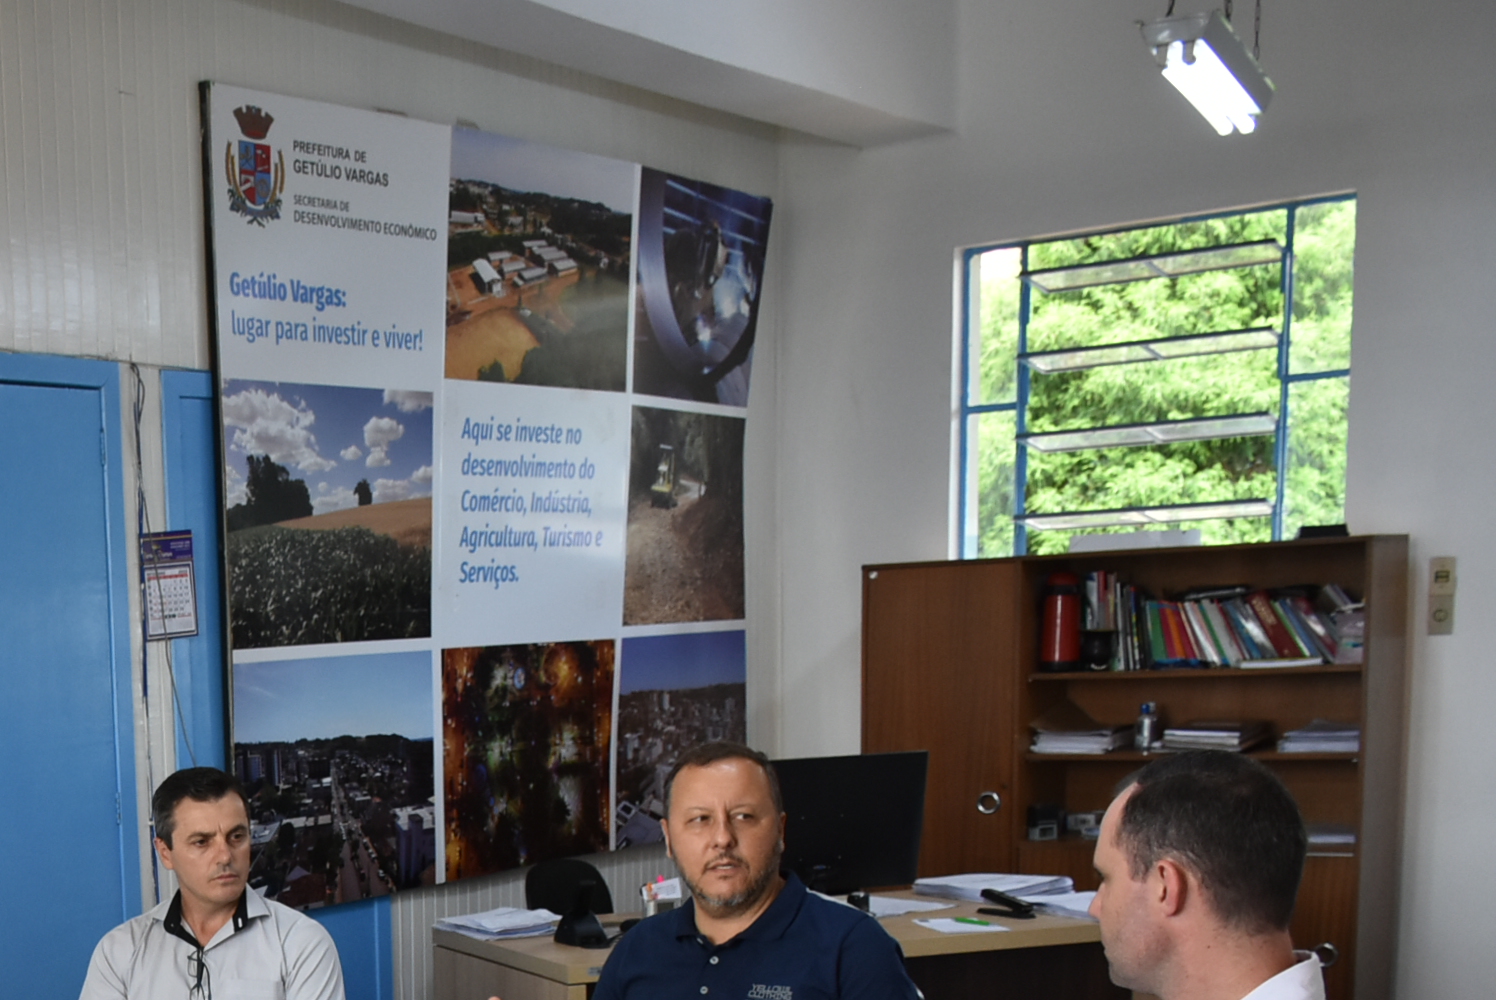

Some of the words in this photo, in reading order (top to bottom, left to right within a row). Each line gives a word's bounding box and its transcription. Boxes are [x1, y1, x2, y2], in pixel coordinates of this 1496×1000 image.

[293, 140, 350, 160] PREFEITURA
[354, 151, 366, 163] DE
[293, 159, 342, 180] GETÚLIO
[344, 167, 389, 187] VARGAS
[293, 195, 338, 211] SECRETARIA
[340, 201, 350, 213] DE
[293, 210, 382, 234] DESENVOLVIMENTO
[383, 222, 437, 241] ECONÔMICO
[229, 272, 287, 302] Getúlio
[290, 279, 347, 312] Vargas:
[231, 309, 271, 343] lugar
[275, 320, 308, 345] para
[313, 316, 368, 347] investir
[371, 329, 380, 348] e
[384, 324, 423, 351] viver!
[461, 415, 494, 446] Aqui
[496, 423, 512, 442] se
[515, 417, 563, 444] investe
[565, 427, 582, 445] no
[461, 452, 576, 479] desenvolvimento
[579, 457, 595, 479] do
[461, 488, 527, 517] Comércio,
[530, 489, 592, 517] Indústria,
[459, 522, 538, 553] Agricultura,
[542, 524, 592, 547] Turismo
[595, 530, 603, 547] e
[459, 558, 519, 590] Serviços.
